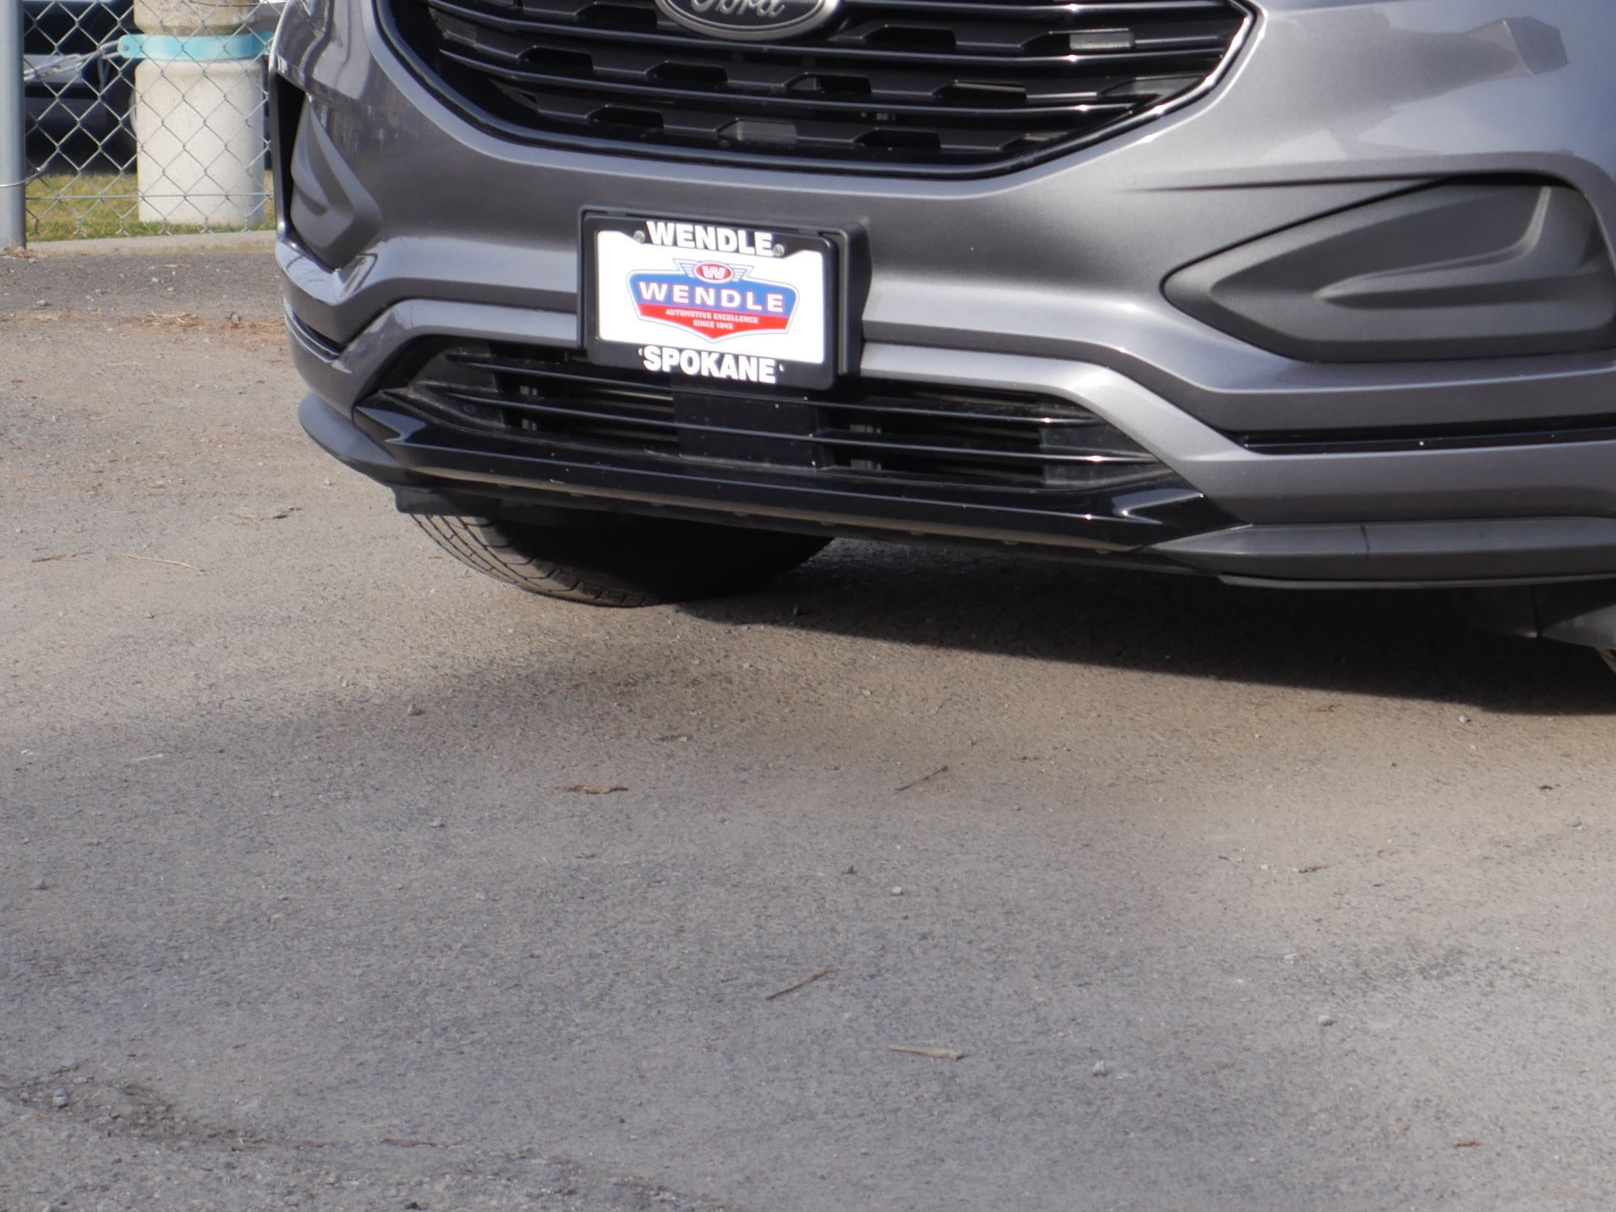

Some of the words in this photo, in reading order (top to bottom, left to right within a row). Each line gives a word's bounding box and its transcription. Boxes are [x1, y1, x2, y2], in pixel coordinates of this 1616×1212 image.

[646, 220, 774, 257] WENDLE
[637, 280, 785, 314] WENDLE
[665, 307, 712, 320] AUTOMOTIVE
[712, 312, 759, 325] EXCELLENCE
[693, 319, 715, 329] SINCE
[642, 345, 776, 384] SPOKANE
